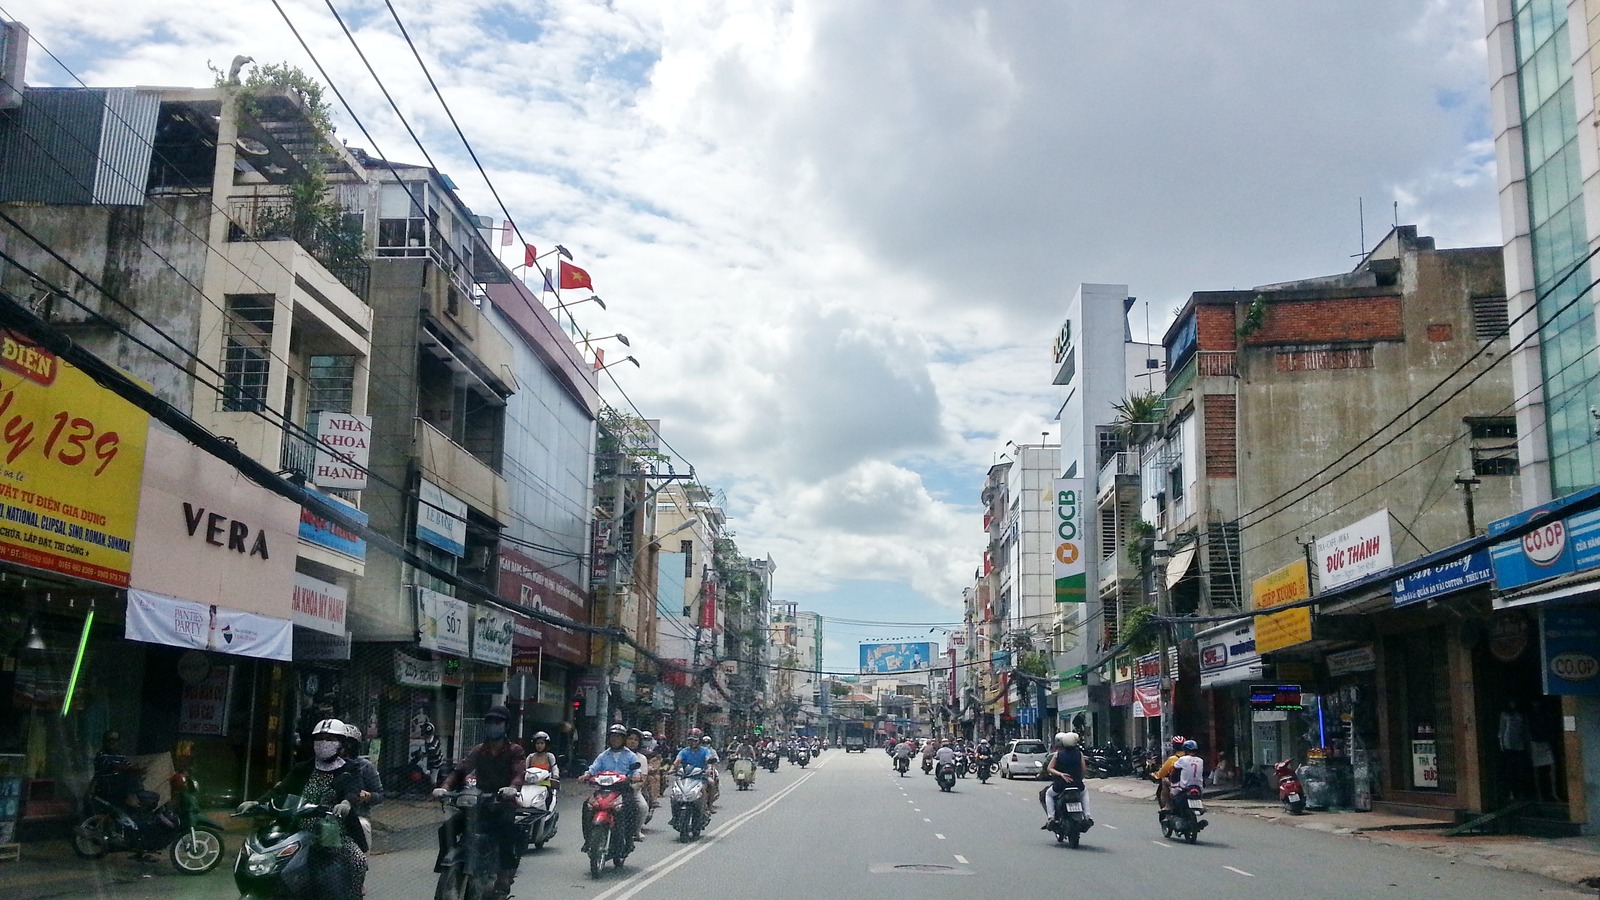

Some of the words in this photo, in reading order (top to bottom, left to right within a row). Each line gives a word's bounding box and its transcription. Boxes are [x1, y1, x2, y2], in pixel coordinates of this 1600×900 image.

[1, 336, 53, 379] ĐIỆN
[328, 418, 364, 433] NHA
[43, 411, 119, 476] 139
[321, 434, 366, 450] KHOA
[318, 465, 365, 481] HẠNH
[35, 494, 60, 513] ĐIỆN
[62, 504, 78, 519] GIA
[1058, 490, 1077, 540] OCB
[182, 502, 269, 560] VERA
[1525, 523, 1562, 552] CO.OP
[1326, 546, 1344, 574] ĐỨC
[1347, 535, 1380, 565] THÀNH
[174, 608, 204, 623] PANTIES
[174, 619, 203, 640] PARTY
